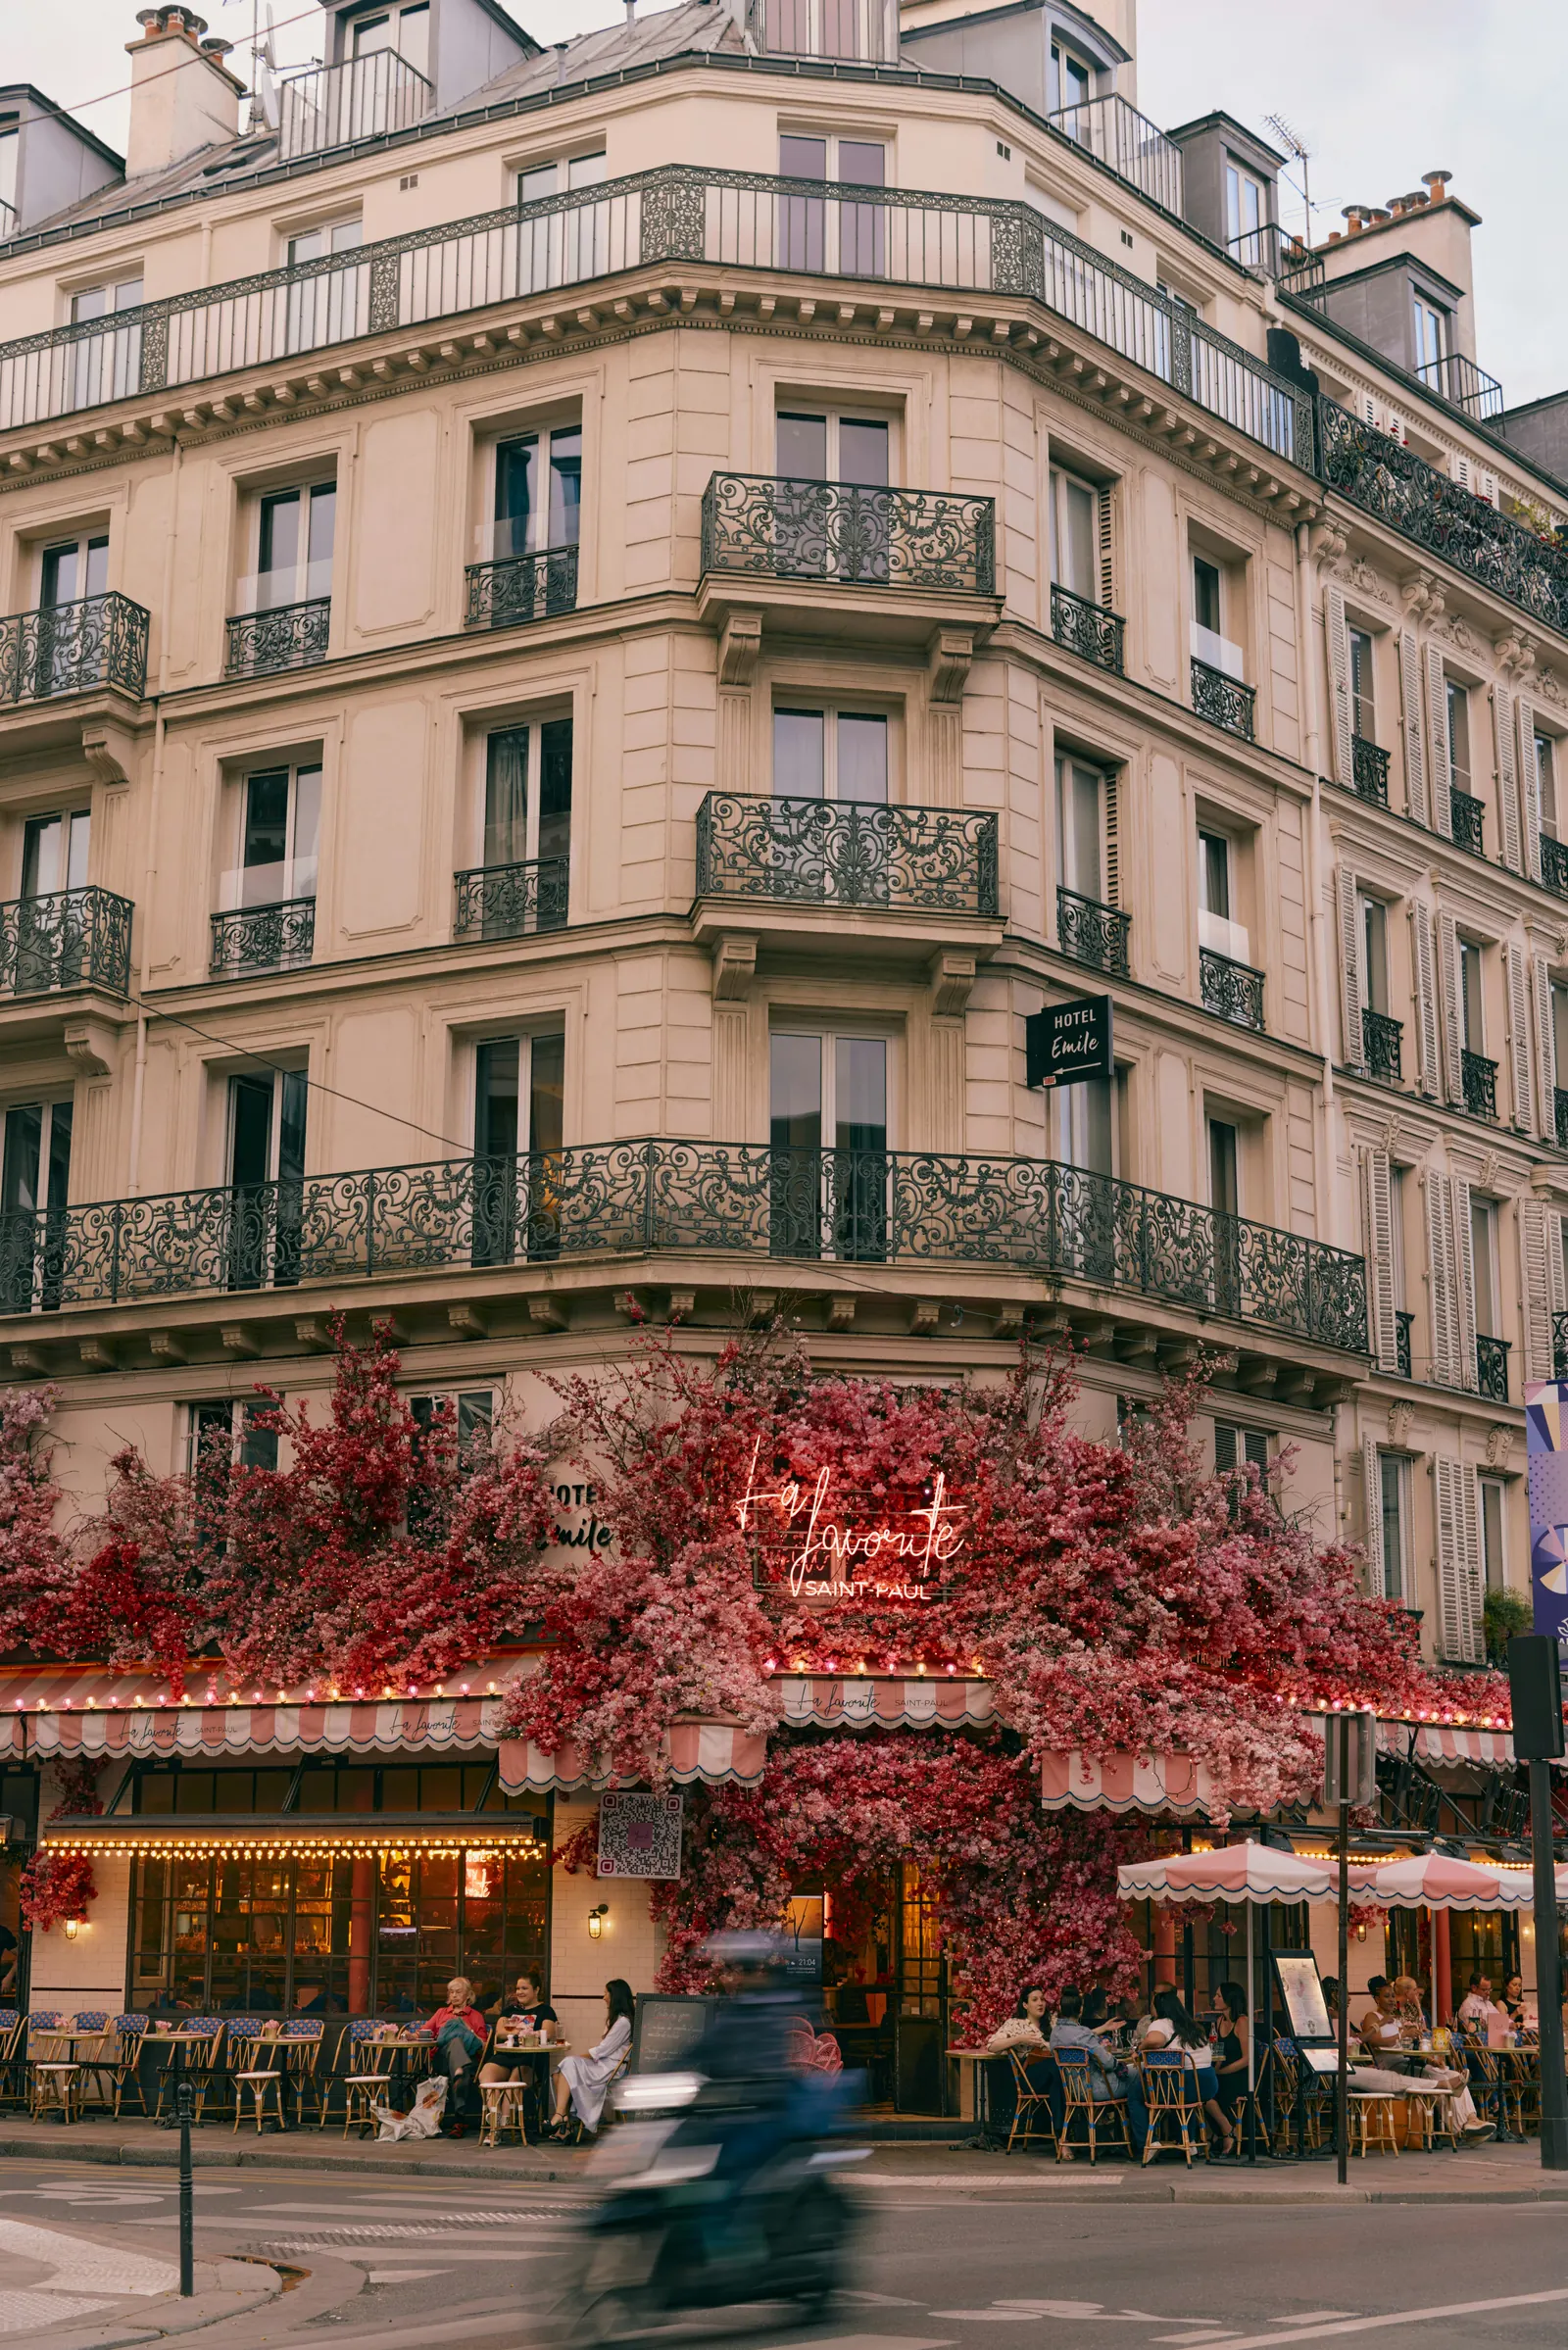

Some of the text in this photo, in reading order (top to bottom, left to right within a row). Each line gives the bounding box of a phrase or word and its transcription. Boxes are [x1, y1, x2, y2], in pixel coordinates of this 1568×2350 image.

[1054, 1008, 1096, 1028] HOTEL
[1052, 1031, 1099, 1058] Emile
[735, 1434, 967, 1597] La favorite
[805, 1580, 932, 1600] SAINT-PAUL
[796, 1683, 822, 1711] La
[824, 1684, 881, 1717] favorite
[119, 1714, 237, 1746] La favorite SAINT-PAUL
[389, 1708, 410, 1735] La
[412, 1706, 462, 1740] favorite
